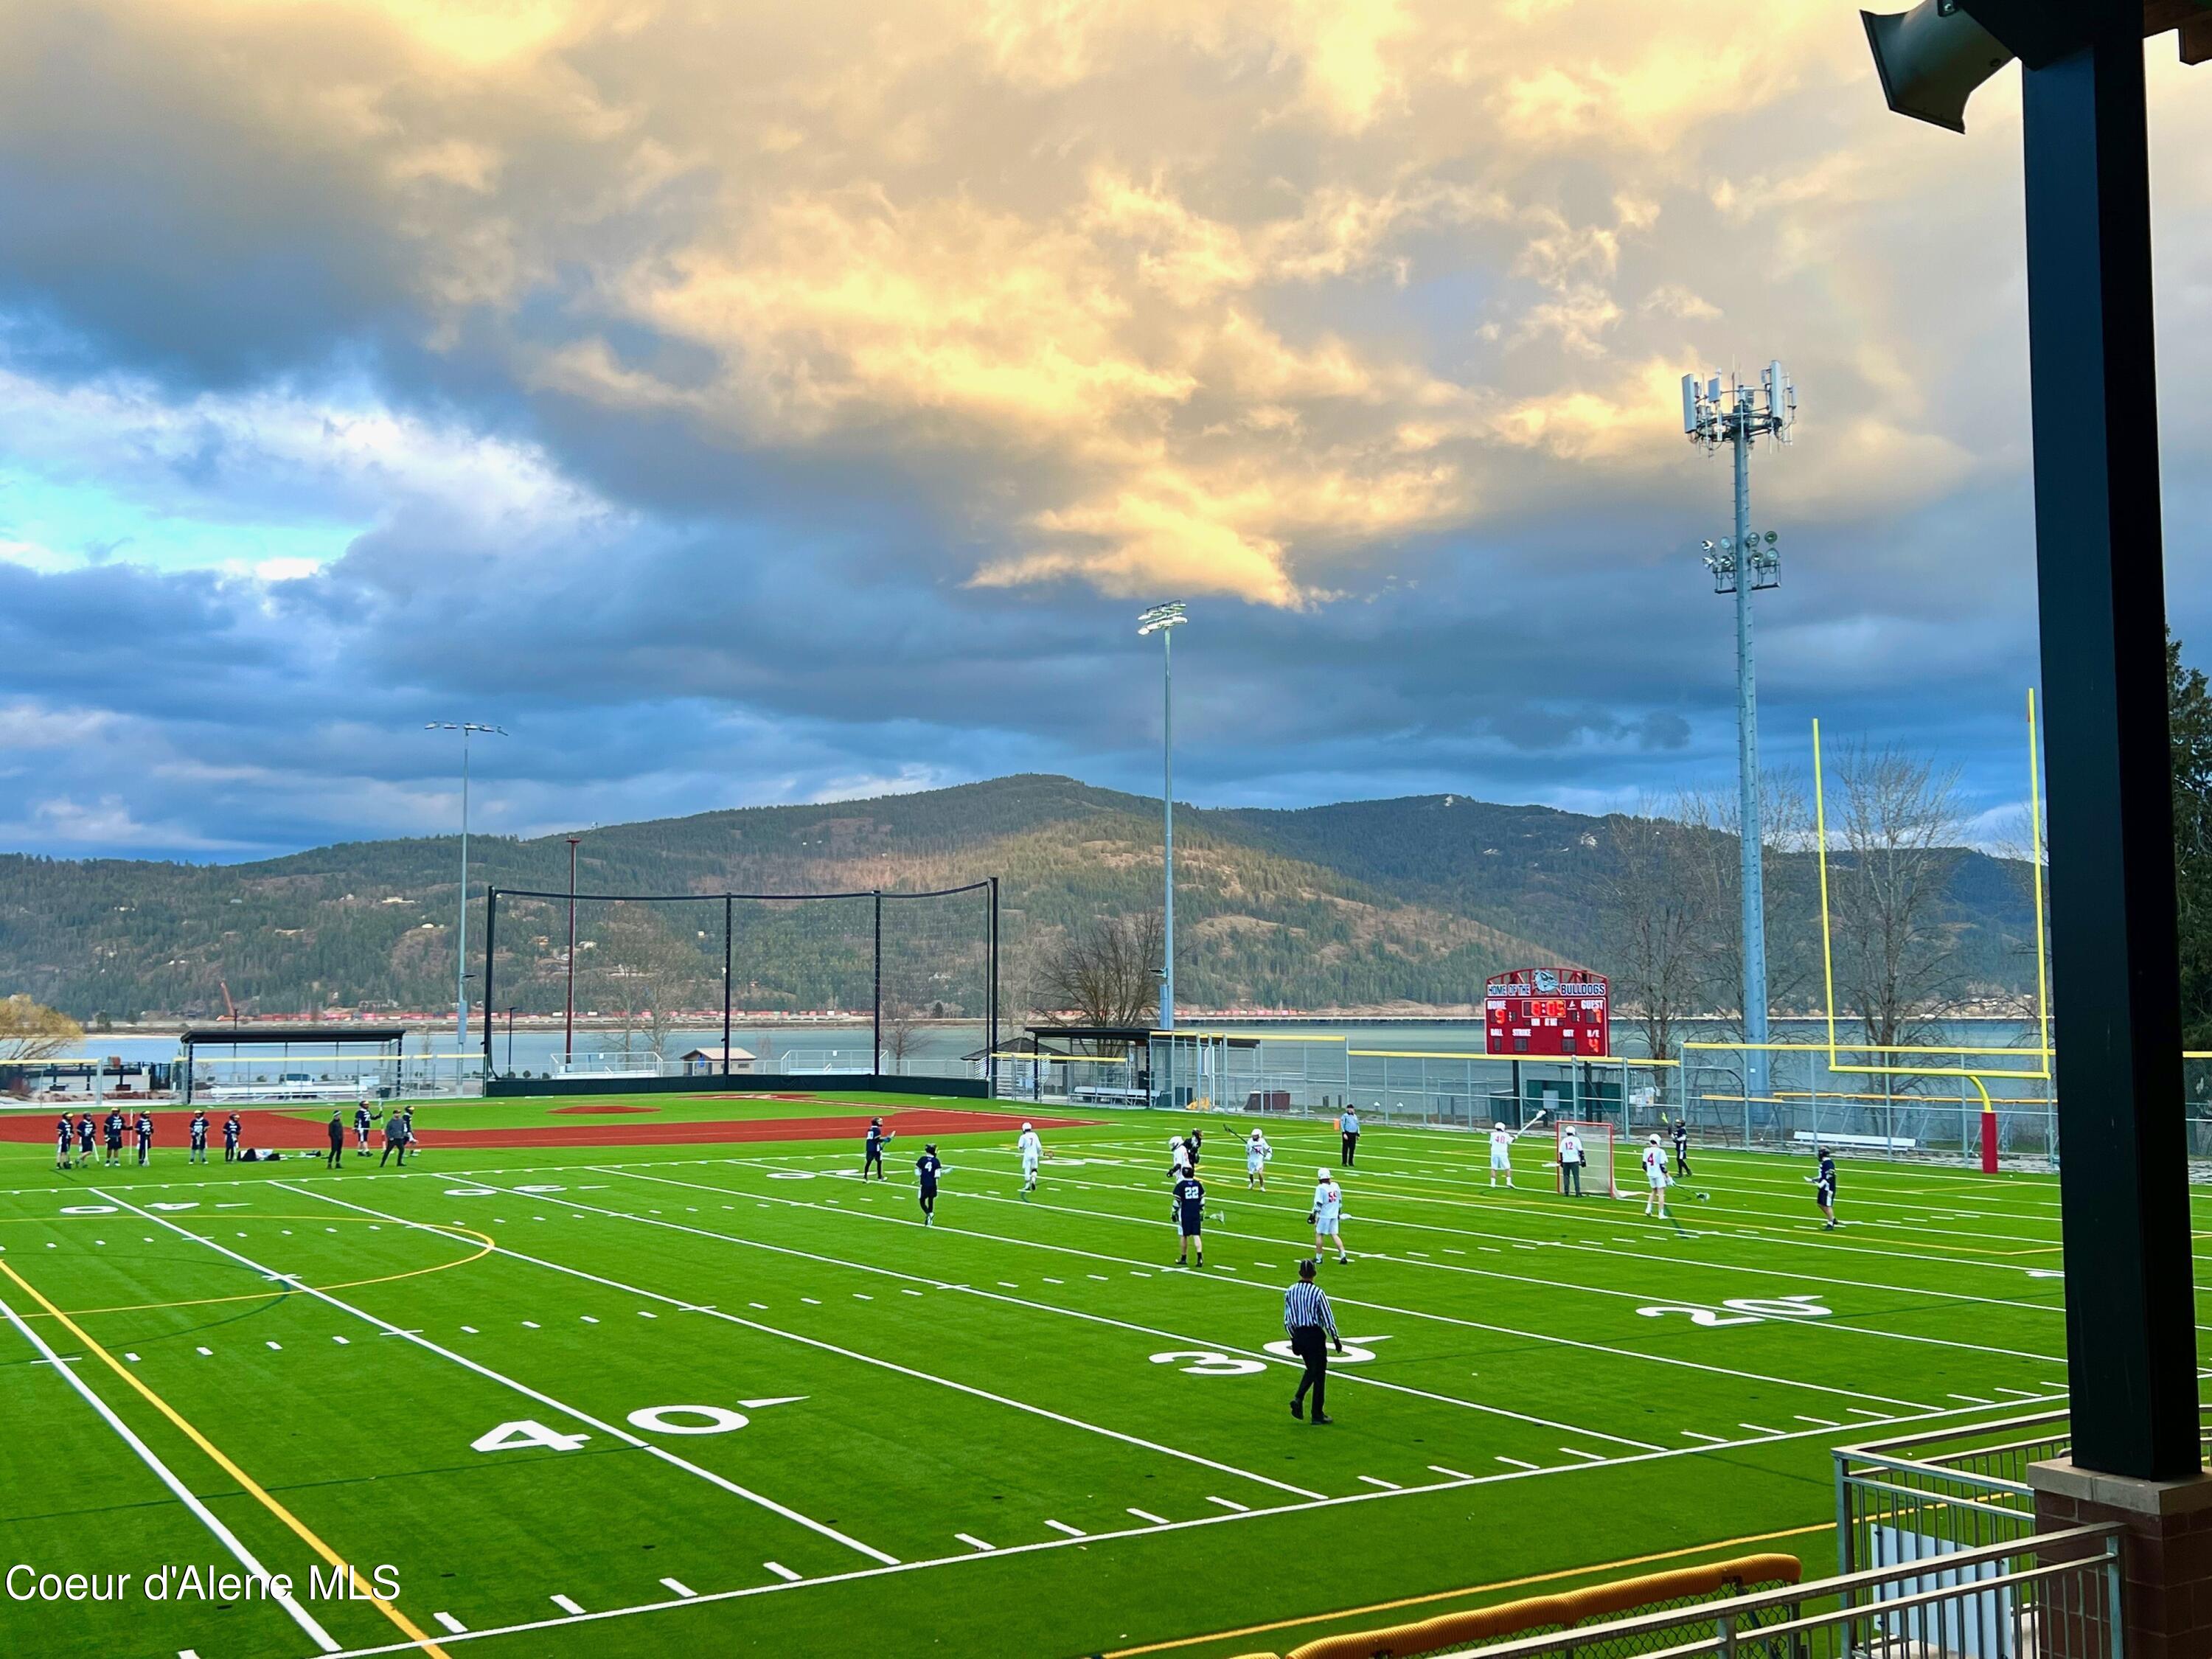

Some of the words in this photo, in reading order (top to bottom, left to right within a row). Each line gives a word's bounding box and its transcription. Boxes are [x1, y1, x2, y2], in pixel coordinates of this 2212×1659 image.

[1488, 984, 1507, 996] HOME
[1518, 984, 1531, 996] THE
[1560, 984, 1605, 995] BULLDOGS
[1581, 1000, 1604, 1009] GUEST
[1495, 1009, 1505, 1023] 9
[1565, 1141, 1573, 1150] 12
[1647, 1152, 1655, 1166] 4
[924, 1161, 933, 1172] 4
[1184, 1186, 1199, 1200] 22
[1635, 1298, 1834, 1326] 20
[470, 1405, 750, 1452] 40
